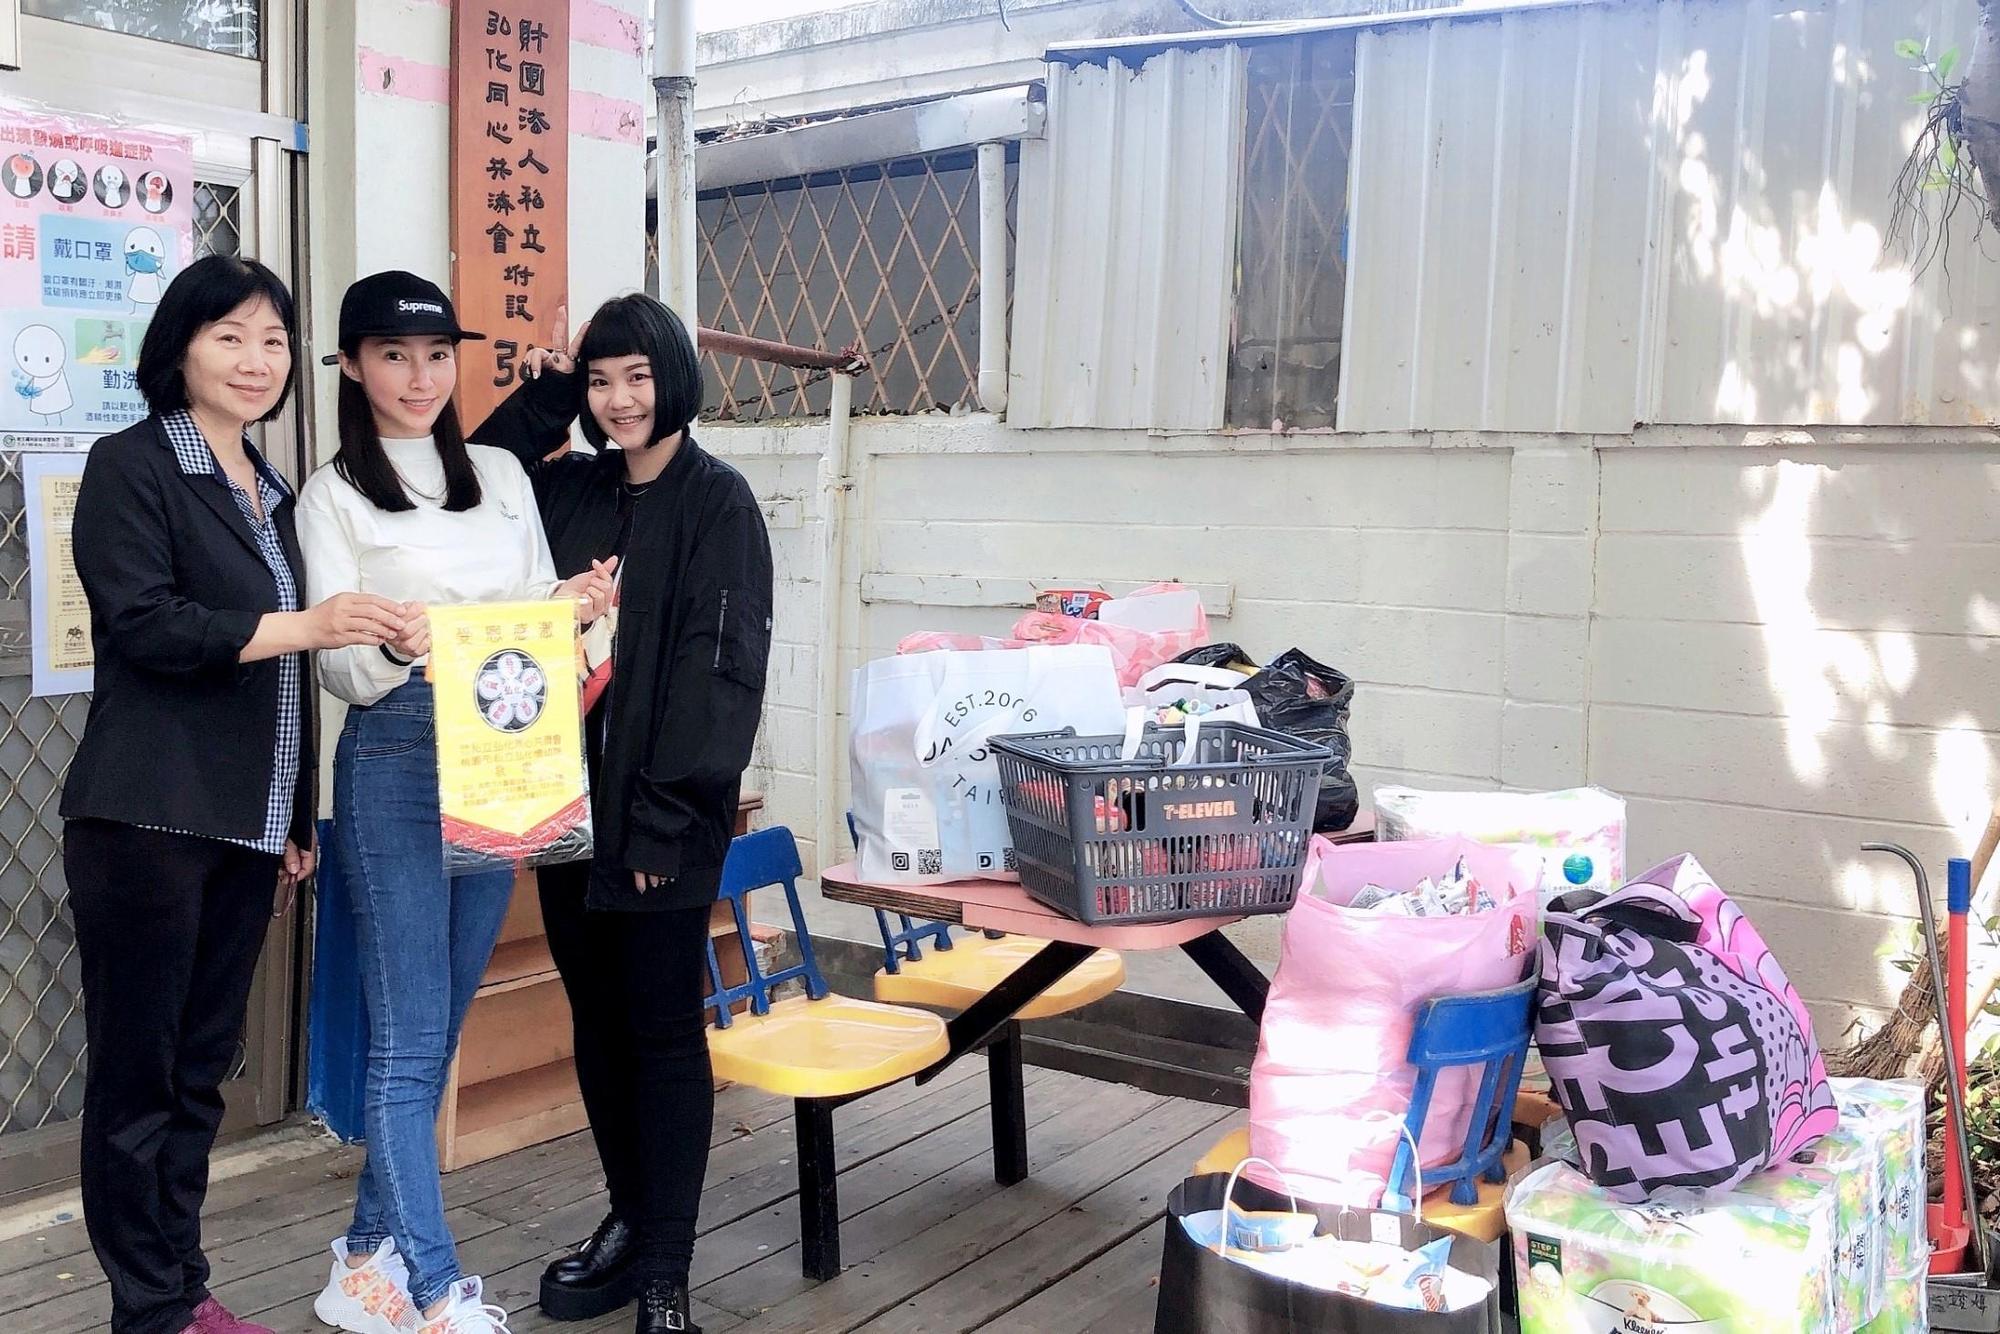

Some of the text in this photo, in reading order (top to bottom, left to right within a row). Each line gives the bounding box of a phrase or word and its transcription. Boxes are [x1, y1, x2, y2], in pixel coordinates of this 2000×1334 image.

[3, 223, 35, 261] 請
[53, 238, 113, 262] 戴口罩
[398, 299, 443, 315] Supreme
